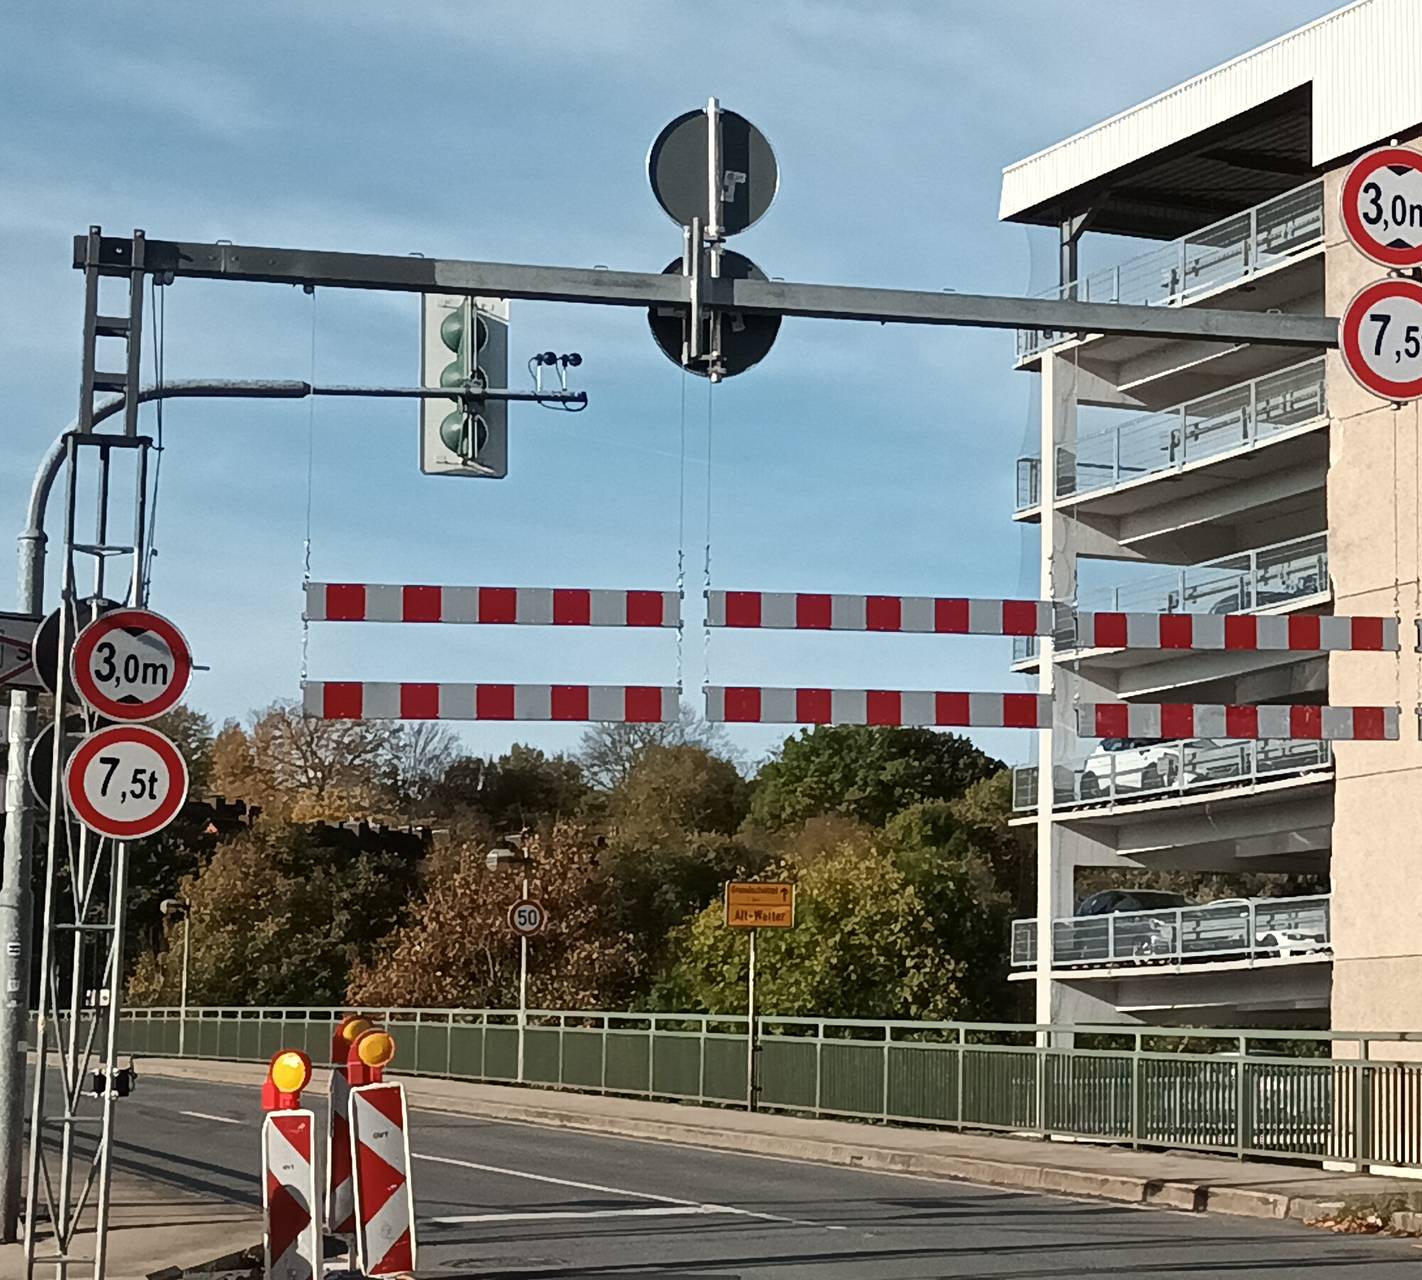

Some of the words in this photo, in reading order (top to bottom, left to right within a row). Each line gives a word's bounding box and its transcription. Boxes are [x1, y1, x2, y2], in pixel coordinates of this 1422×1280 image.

[94, 642, 168, 687] 3,0m
[99, 757, 158, 803] 7,5t
[518, 910, 537, 925] 50
